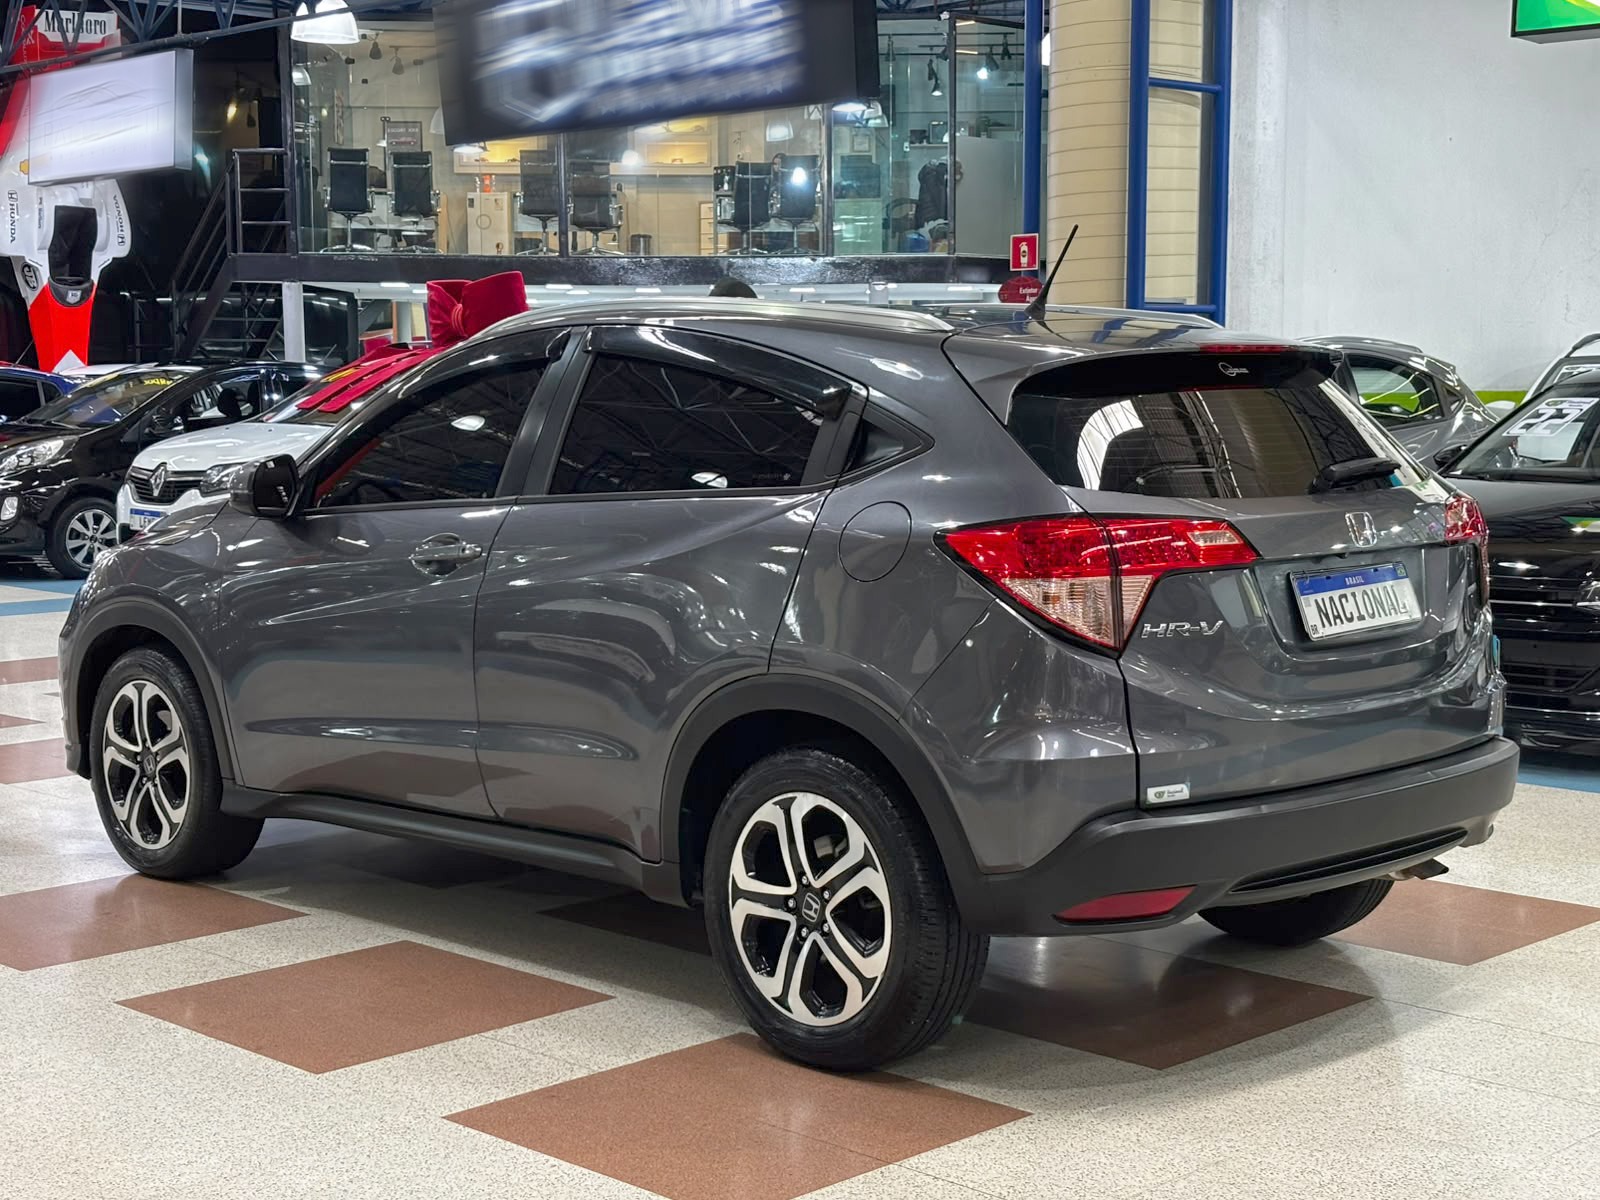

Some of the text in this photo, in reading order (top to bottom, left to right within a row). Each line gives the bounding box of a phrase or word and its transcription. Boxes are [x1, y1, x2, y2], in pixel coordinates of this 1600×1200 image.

[113, 194, 125, 233] HONDA
[1508, 408, 1582, 434] 22
[1345, 575, 1365, 586] BRASIL
[1314, 585, 1409, 629] NACIONAL
[1141, 620, 1224, 639] HR-V
